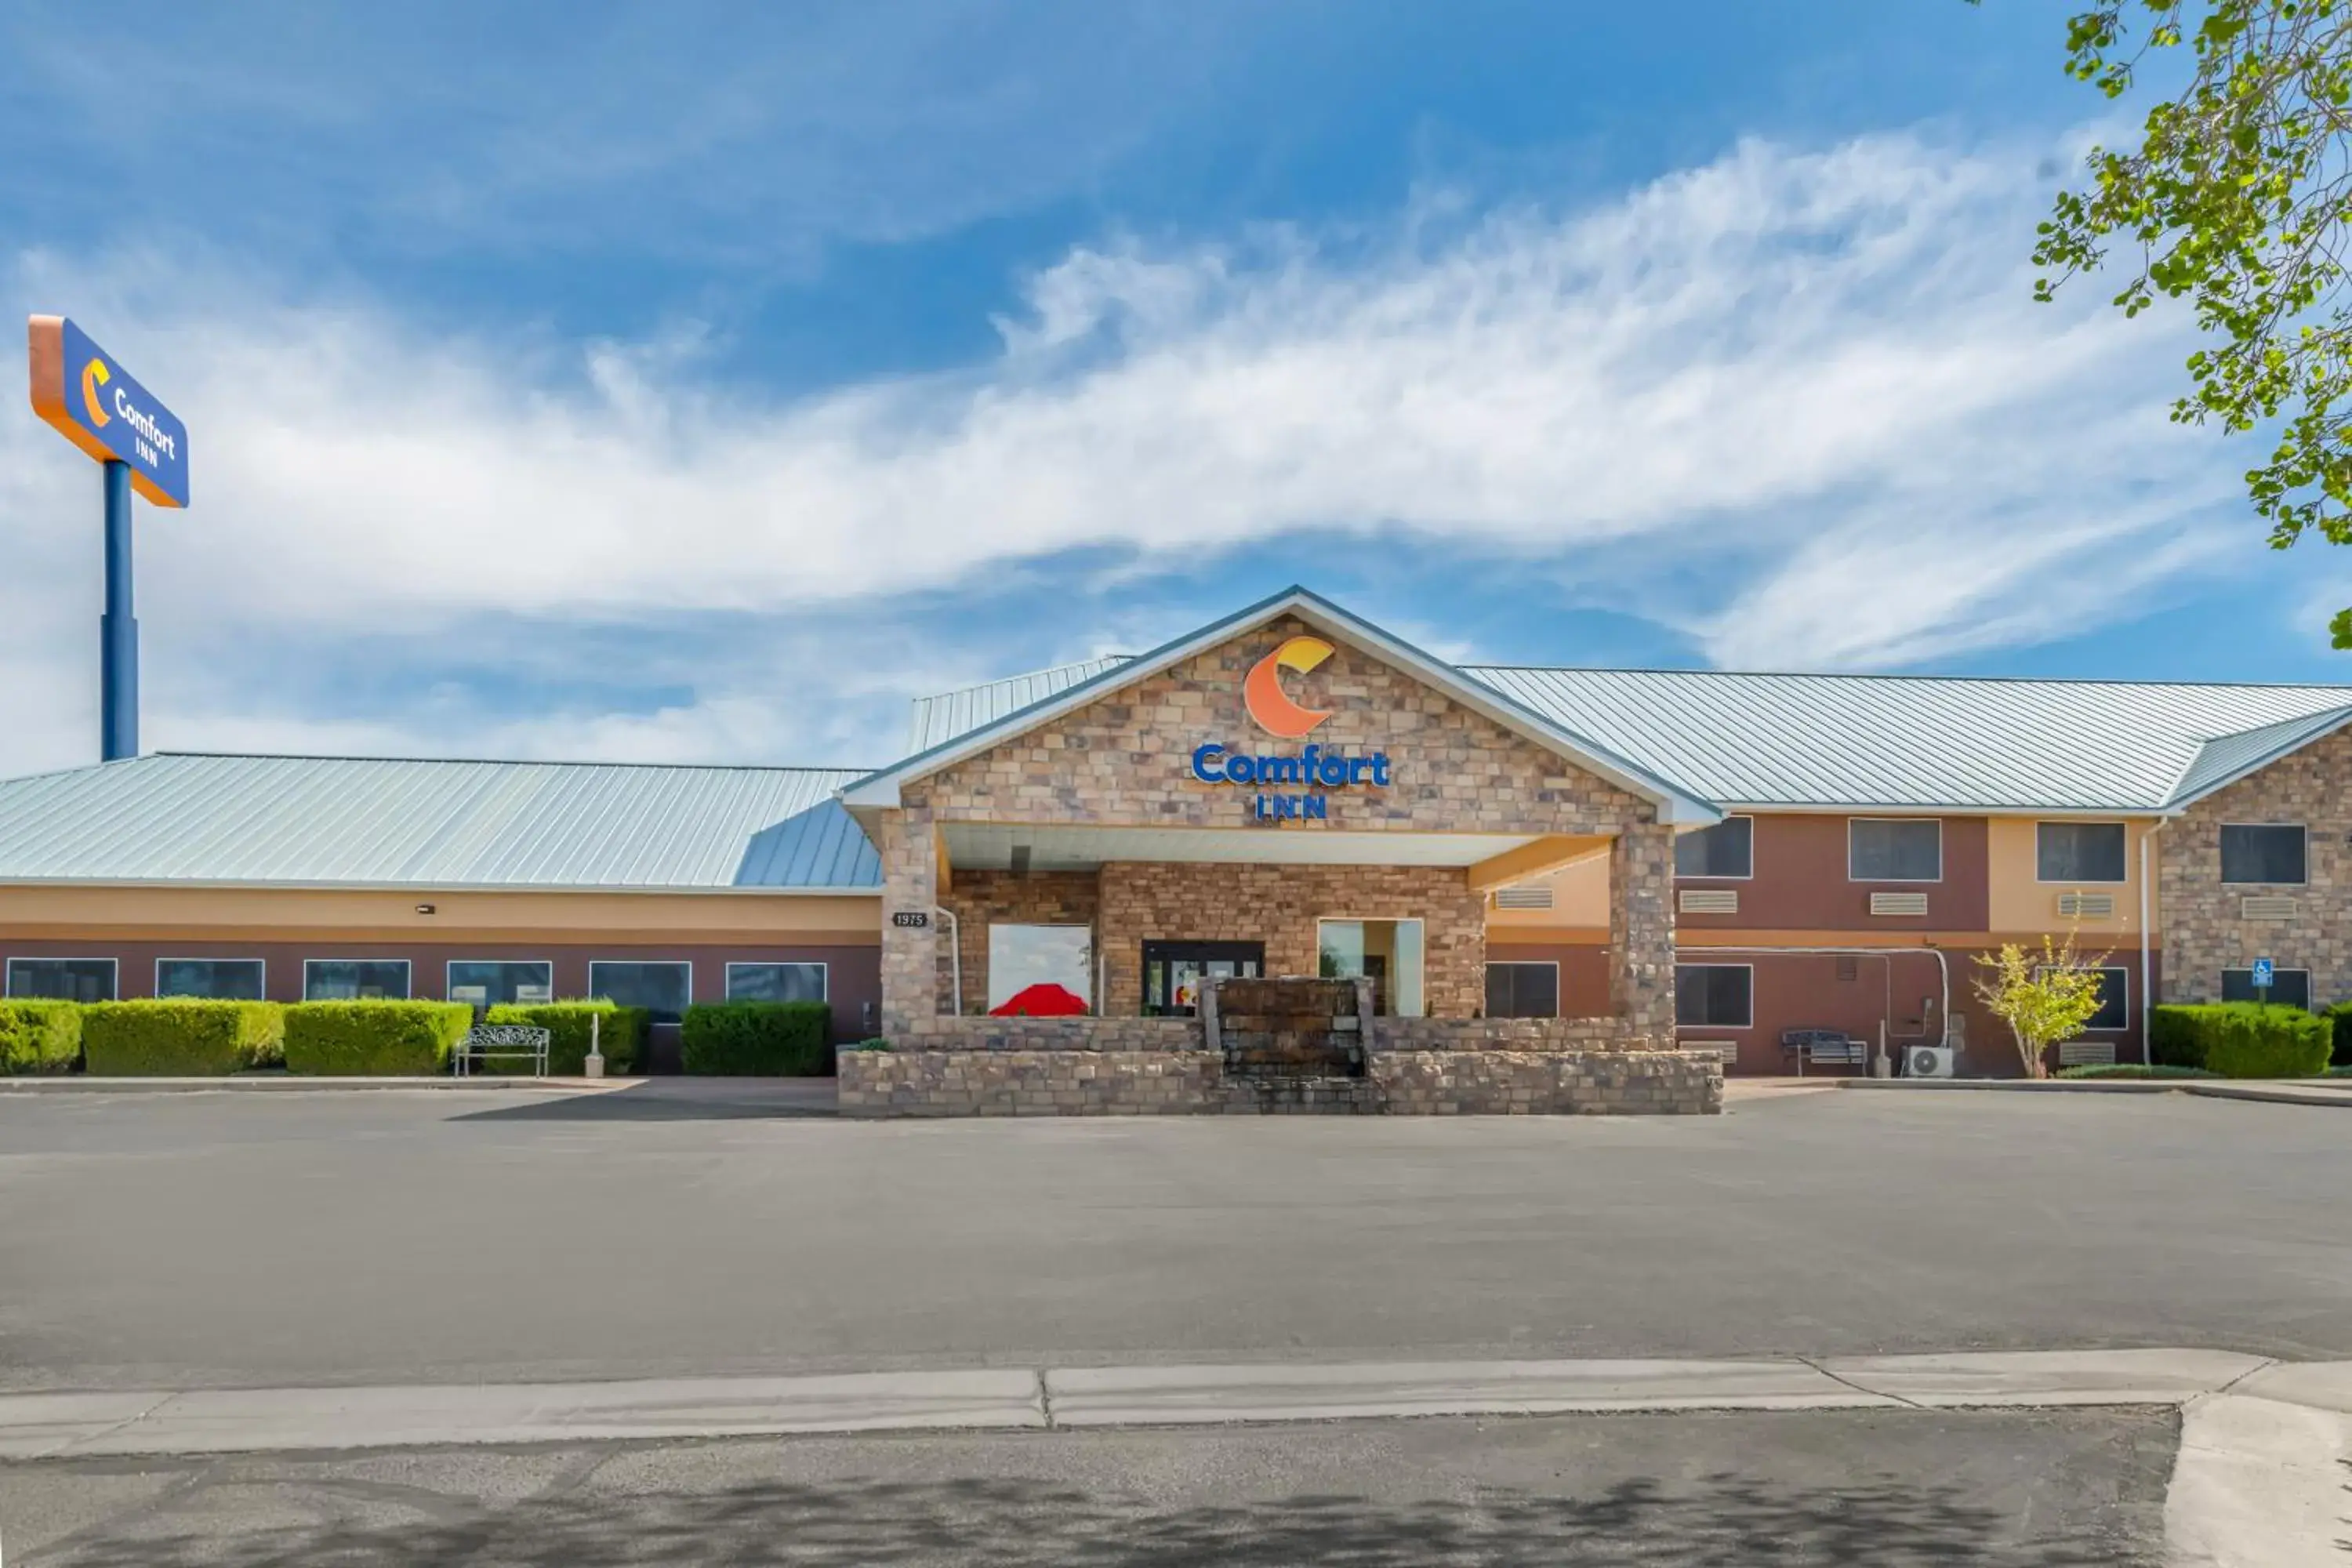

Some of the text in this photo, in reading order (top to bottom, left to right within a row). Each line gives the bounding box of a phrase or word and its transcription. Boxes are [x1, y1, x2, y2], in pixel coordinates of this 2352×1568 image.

[115, 388, 175, 459] Comfort
[136, 437, 157, 467] INN
[1192, 744, 1390, 786] Comfort
[1255, 794, 1327, 819] INN
